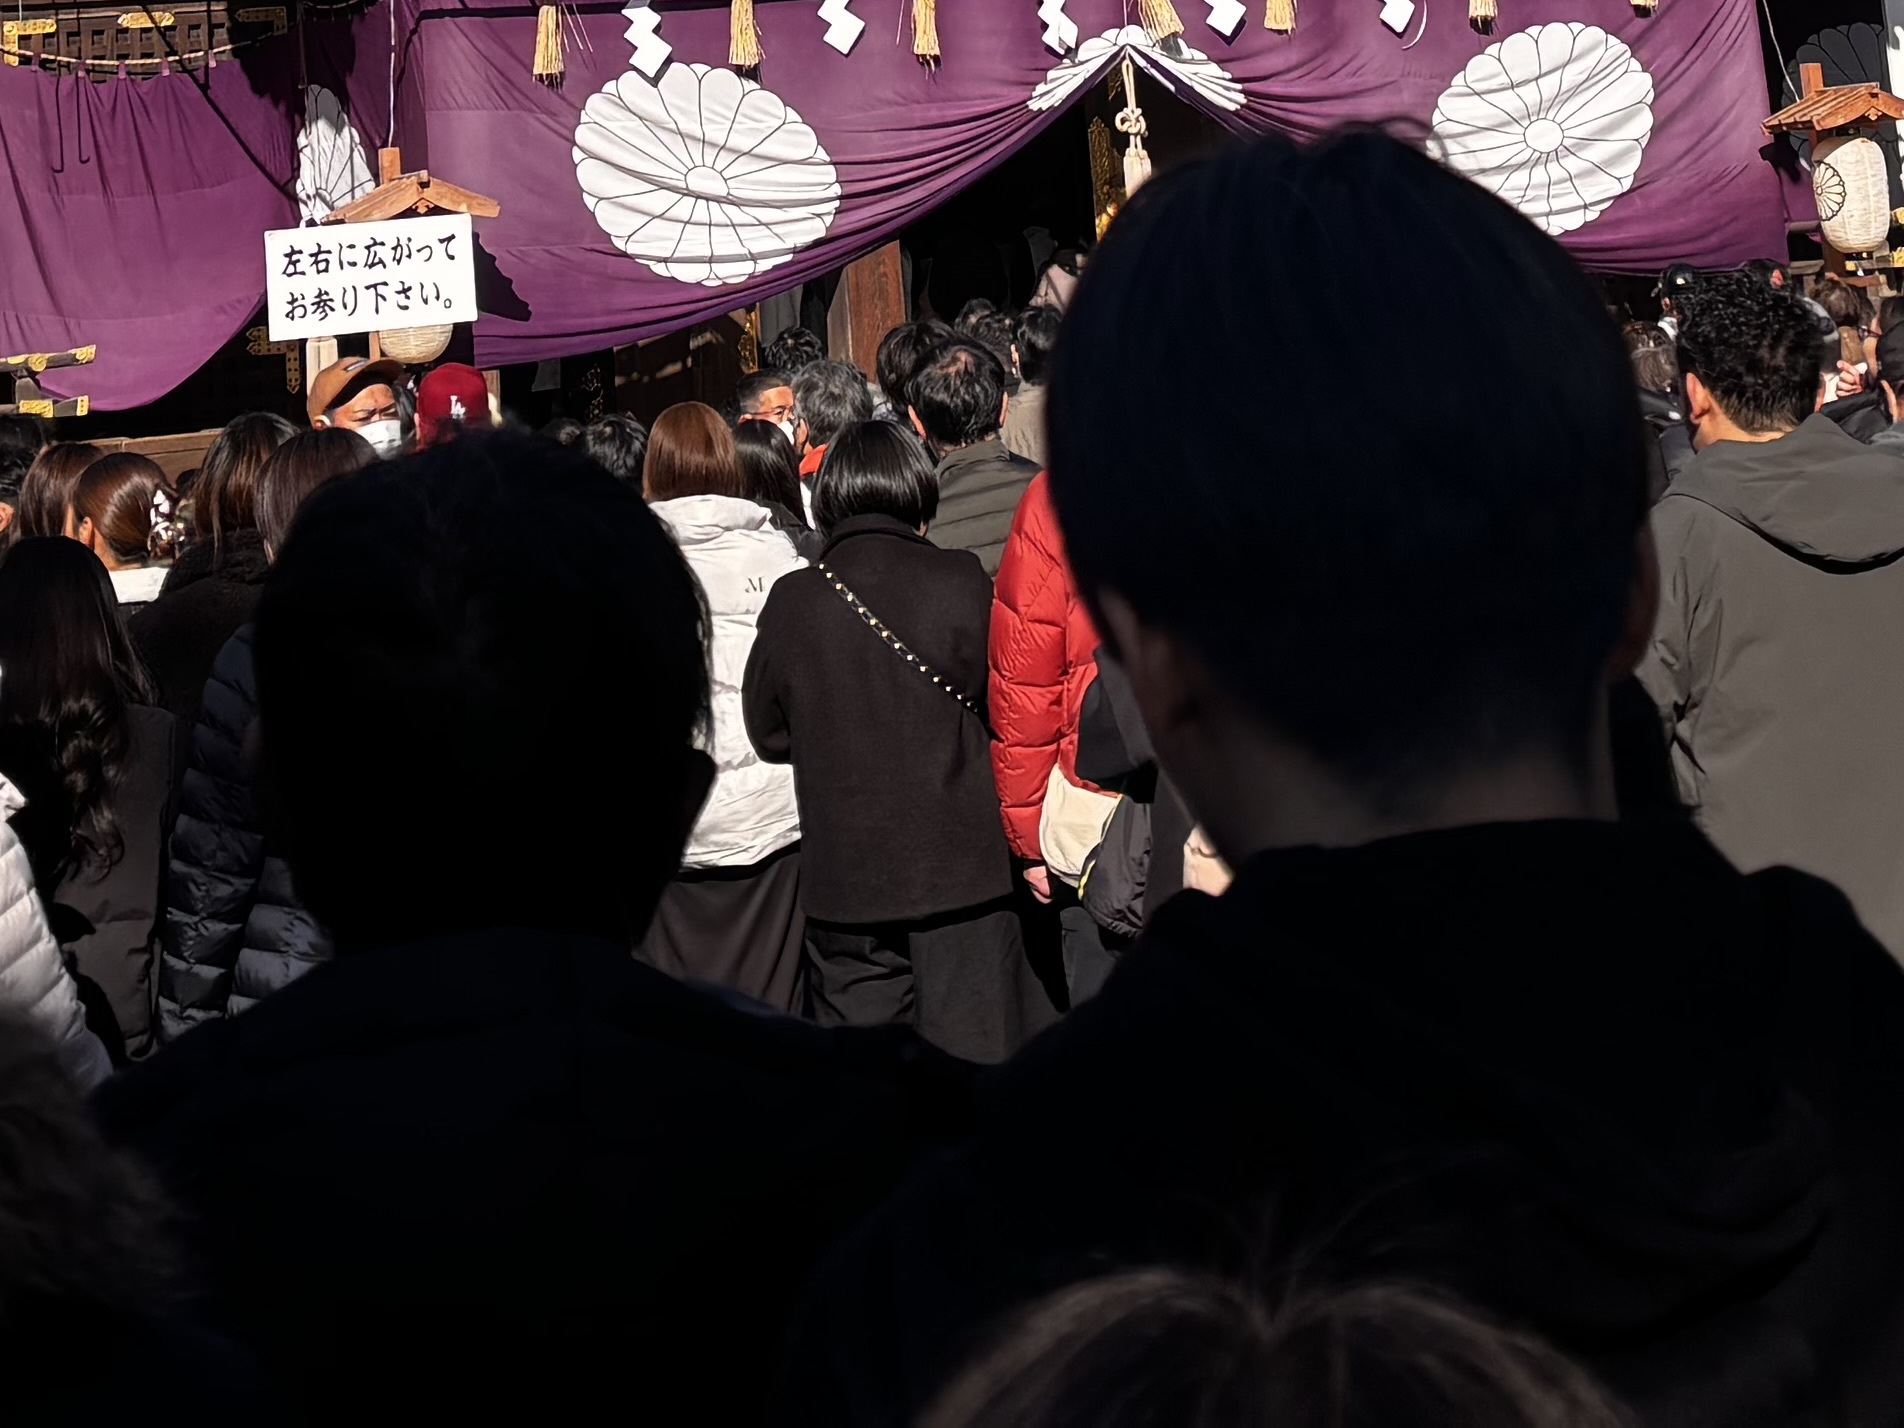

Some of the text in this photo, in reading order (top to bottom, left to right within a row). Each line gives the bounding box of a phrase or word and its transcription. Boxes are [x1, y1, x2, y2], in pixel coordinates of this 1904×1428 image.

[281, 233, 457, 278] 左右に広がって
[284, 280, 453, 322] お参り下さい。
